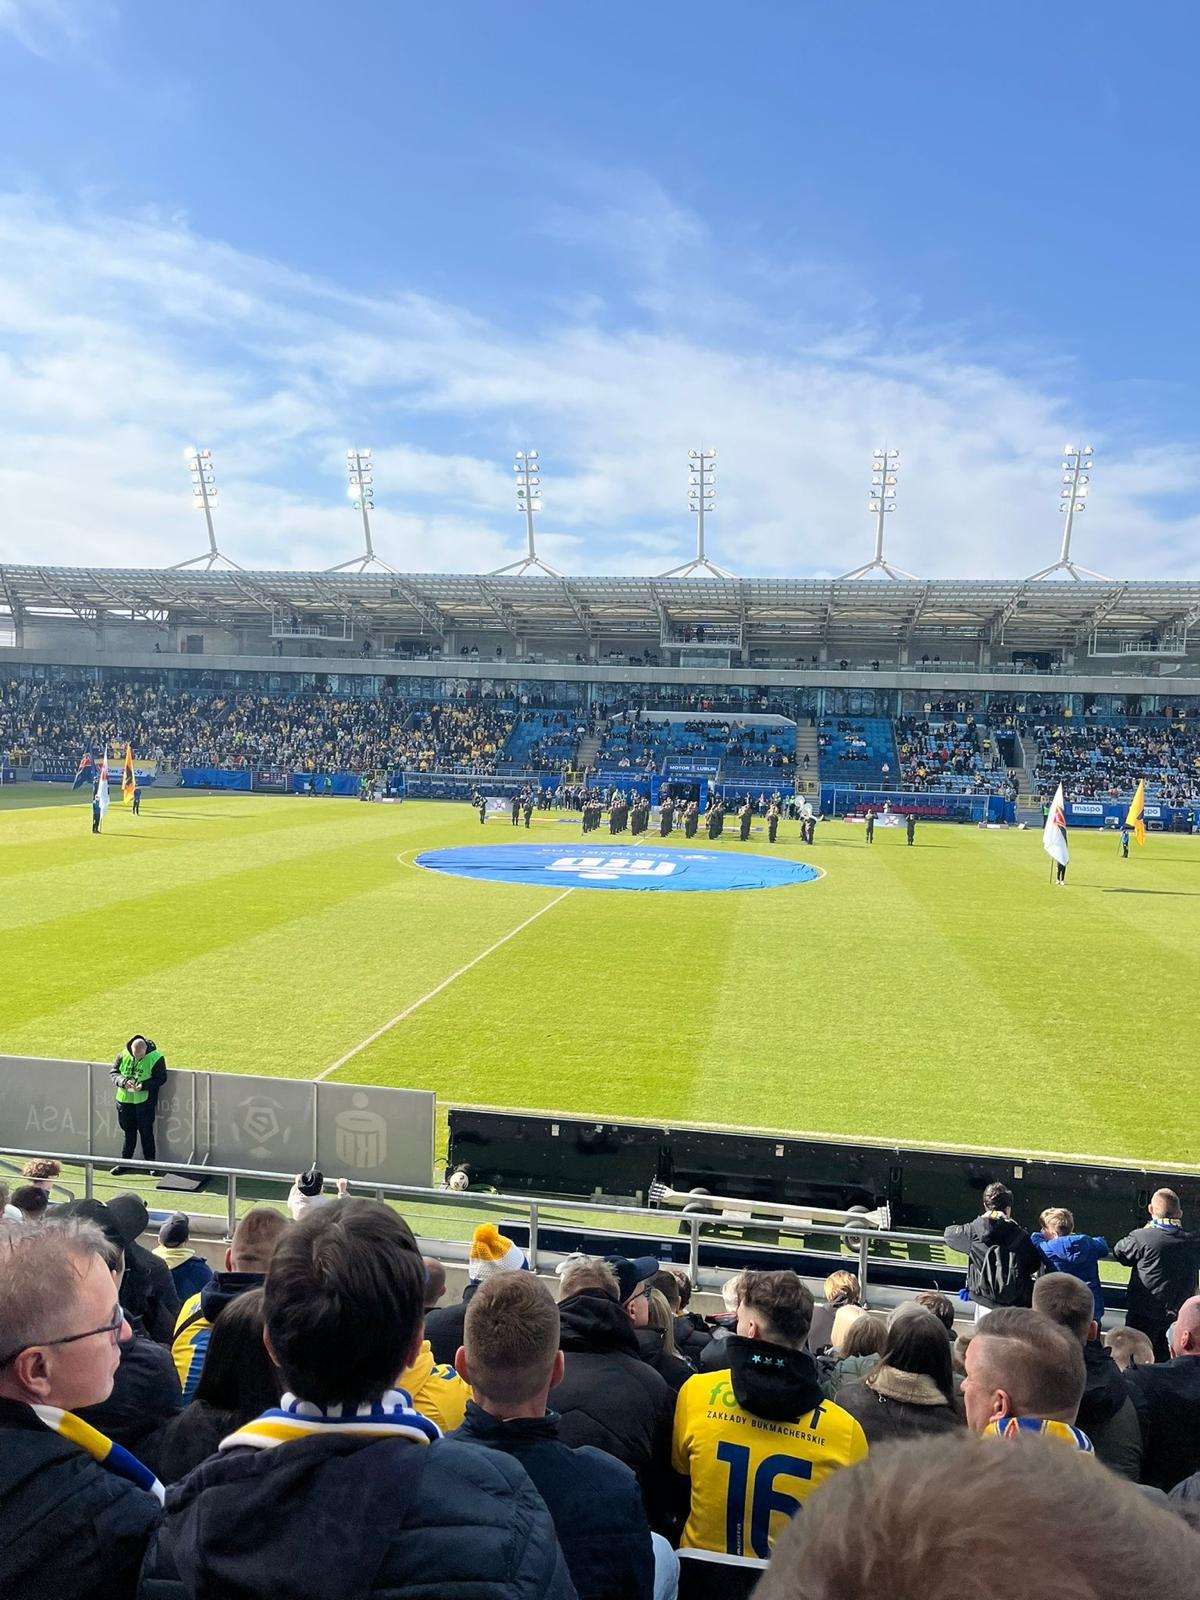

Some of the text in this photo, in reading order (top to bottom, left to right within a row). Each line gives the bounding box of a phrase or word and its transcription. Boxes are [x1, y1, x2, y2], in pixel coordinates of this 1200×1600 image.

[1074, 805, 1101, 814] maspo
[708, 1381, 827, 1431] foT
[706, 1410, 826, 1447] ZAKŁADY BUKMACHERSKIE
[716, 1440, 813, 1560] 16
